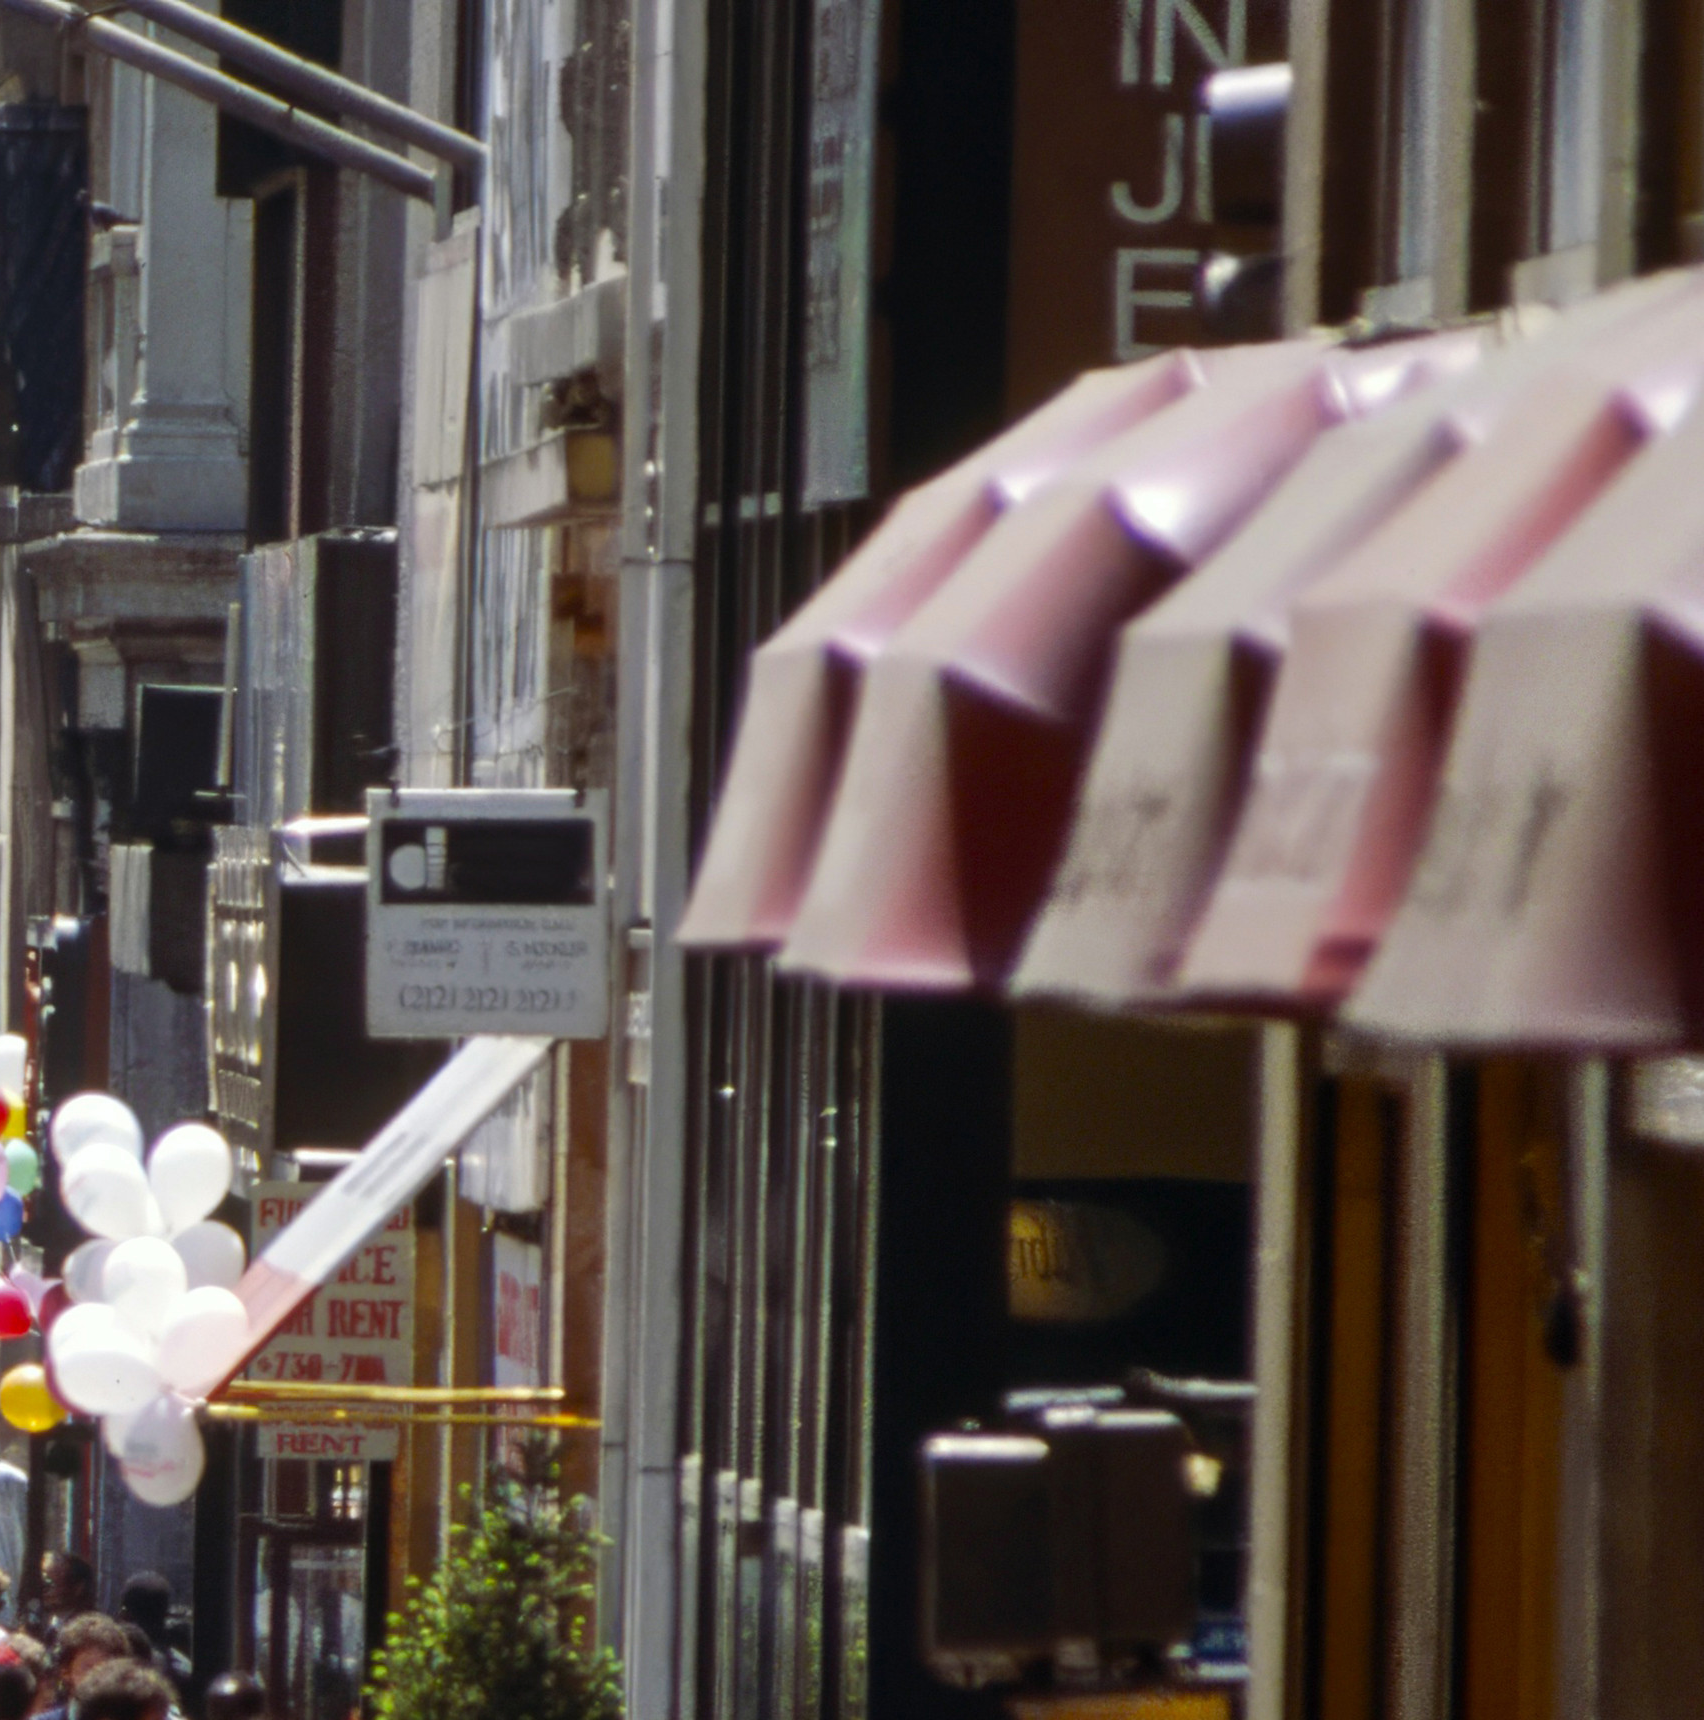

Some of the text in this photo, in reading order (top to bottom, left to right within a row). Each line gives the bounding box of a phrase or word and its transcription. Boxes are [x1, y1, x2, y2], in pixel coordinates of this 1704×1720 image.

[336, 1245, 397, 1286] ICE
[326, 1300, 404, 1340] RENT
[276, 1431, 367, 1455] RENT
